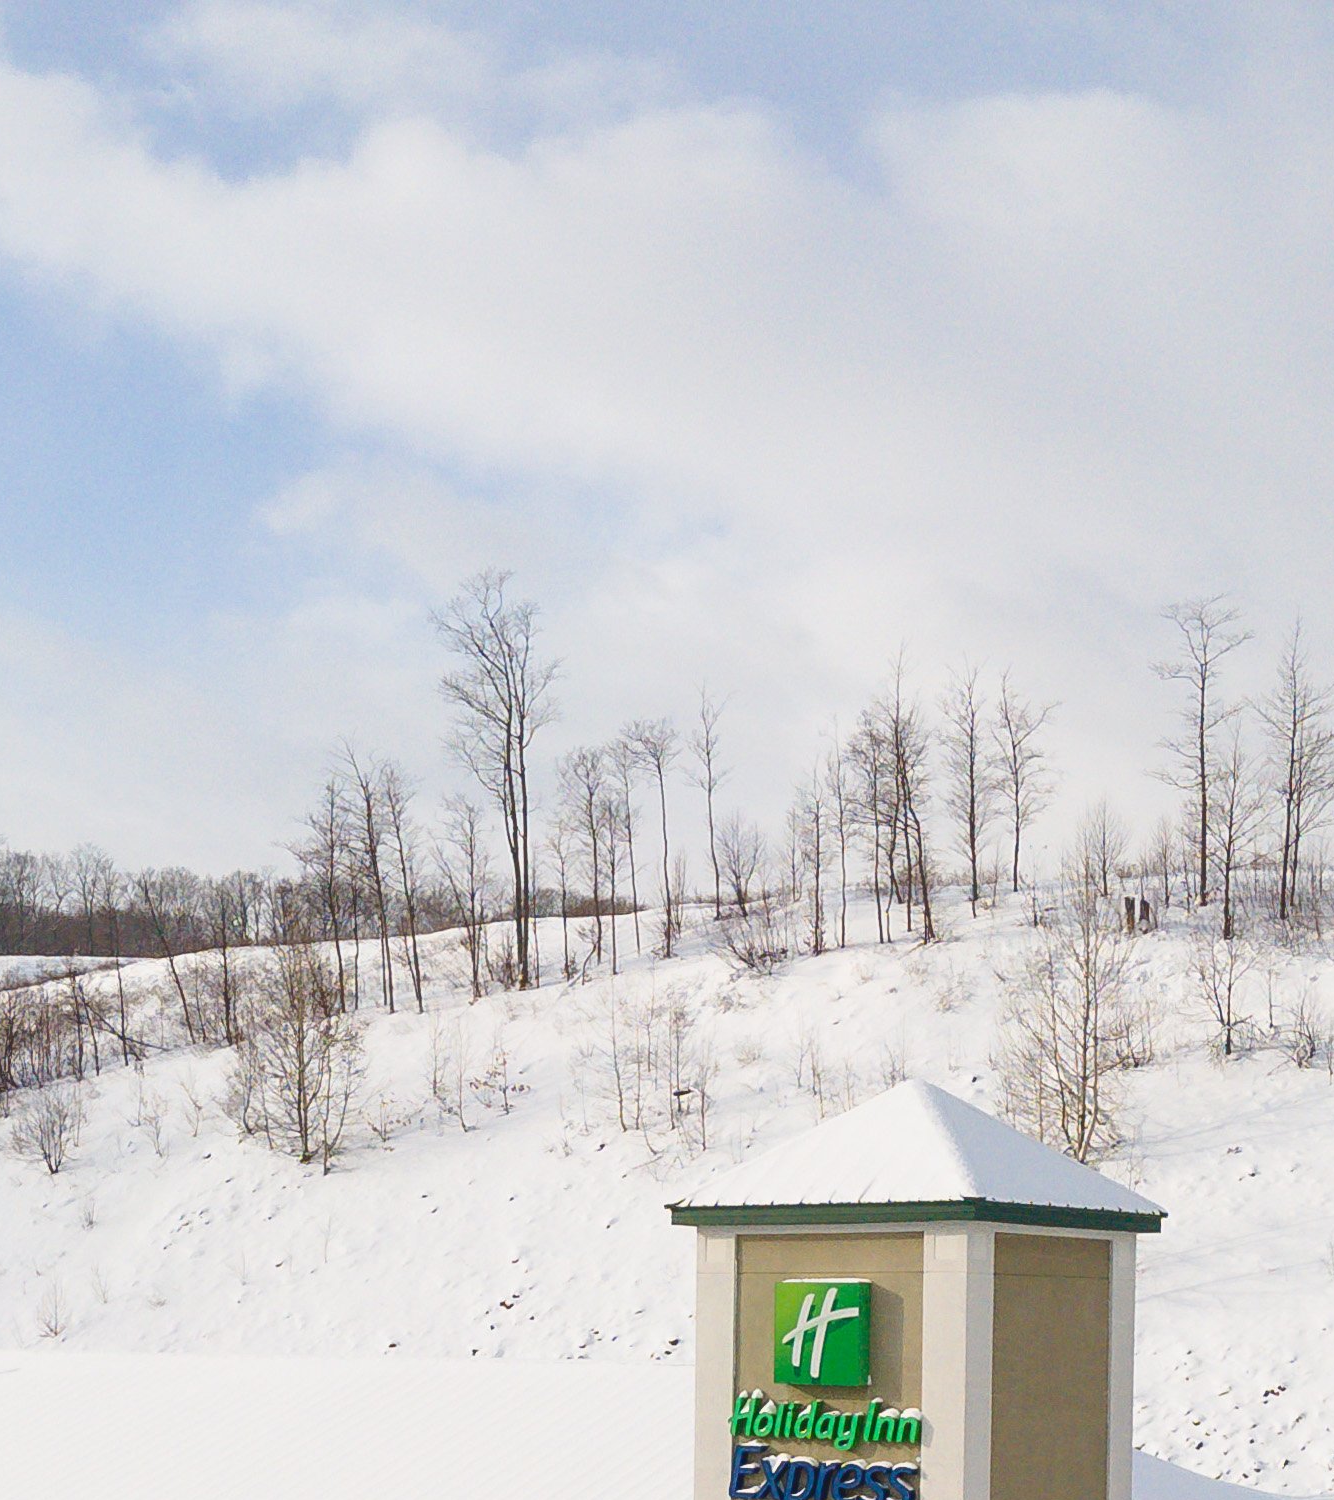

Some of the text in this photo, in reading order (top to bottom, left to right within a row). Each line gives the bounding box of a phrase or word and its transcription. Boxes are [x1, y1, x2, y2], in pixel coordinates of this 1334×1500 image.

[782, 1287, 859, 1379] H
[730, 1396, 922, 1451] Holiday Inn
